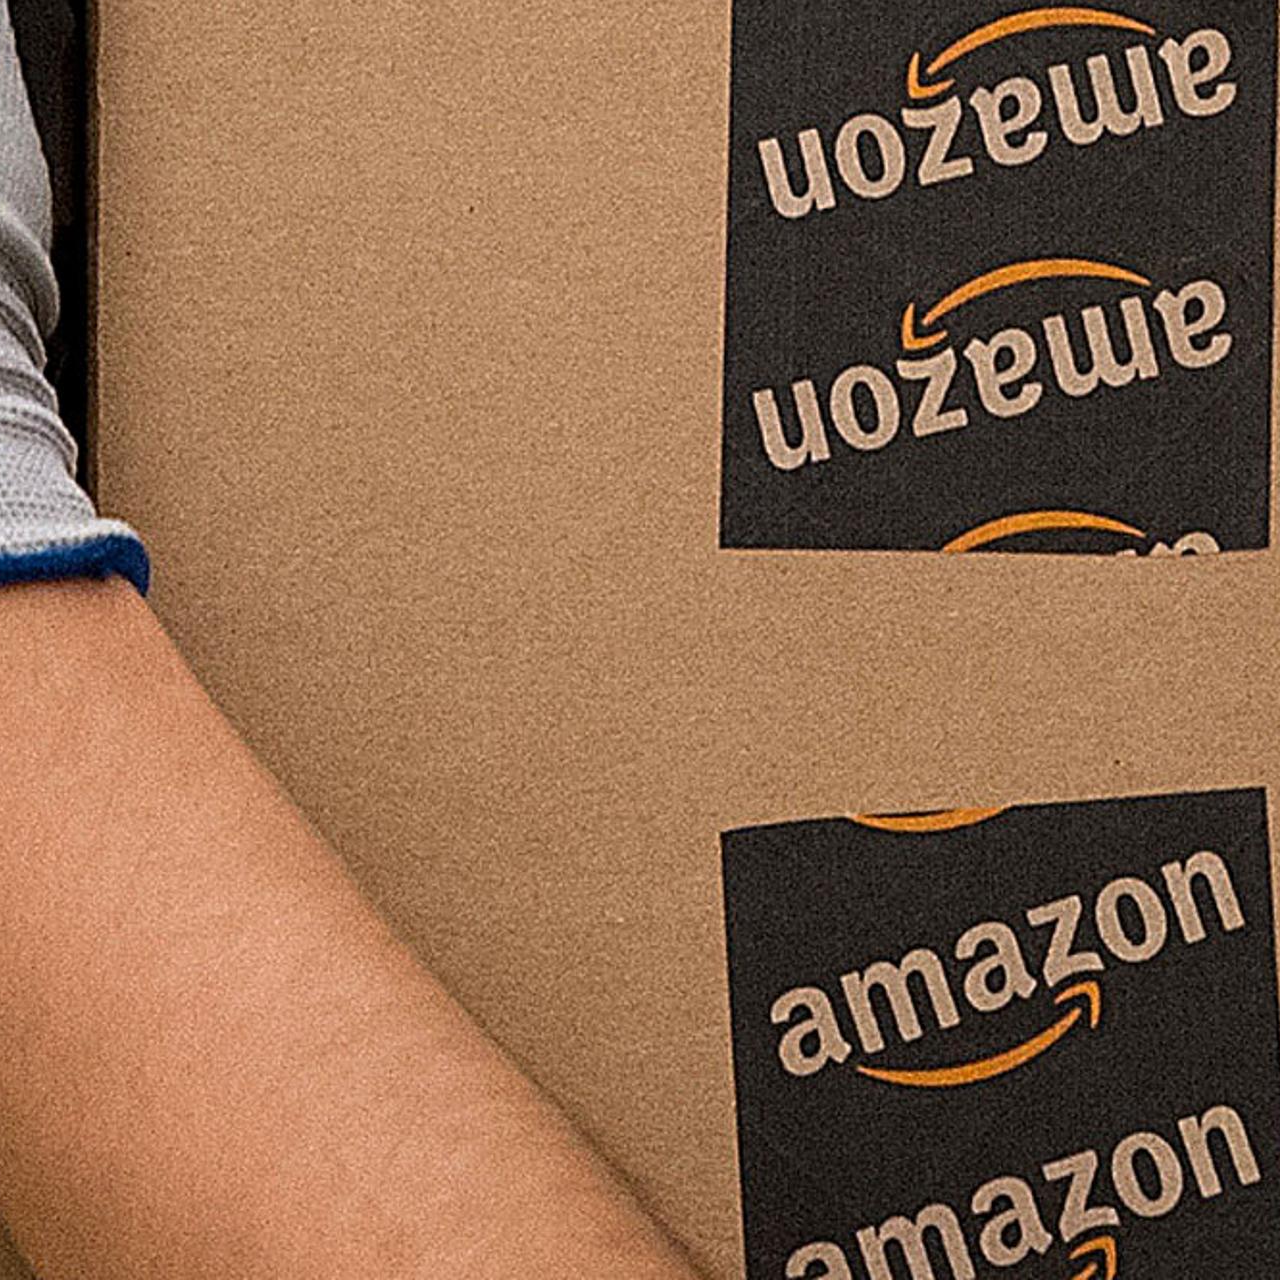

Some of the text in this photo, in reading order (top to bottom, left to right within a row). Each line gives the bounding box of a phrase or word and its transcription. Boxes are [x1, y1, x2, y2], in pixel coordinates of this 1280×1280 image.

[757, 28, 1237, 219] amazon
[752, 279, 1233, 471] amazon
[770, 850, 1246, 1076] amazon
